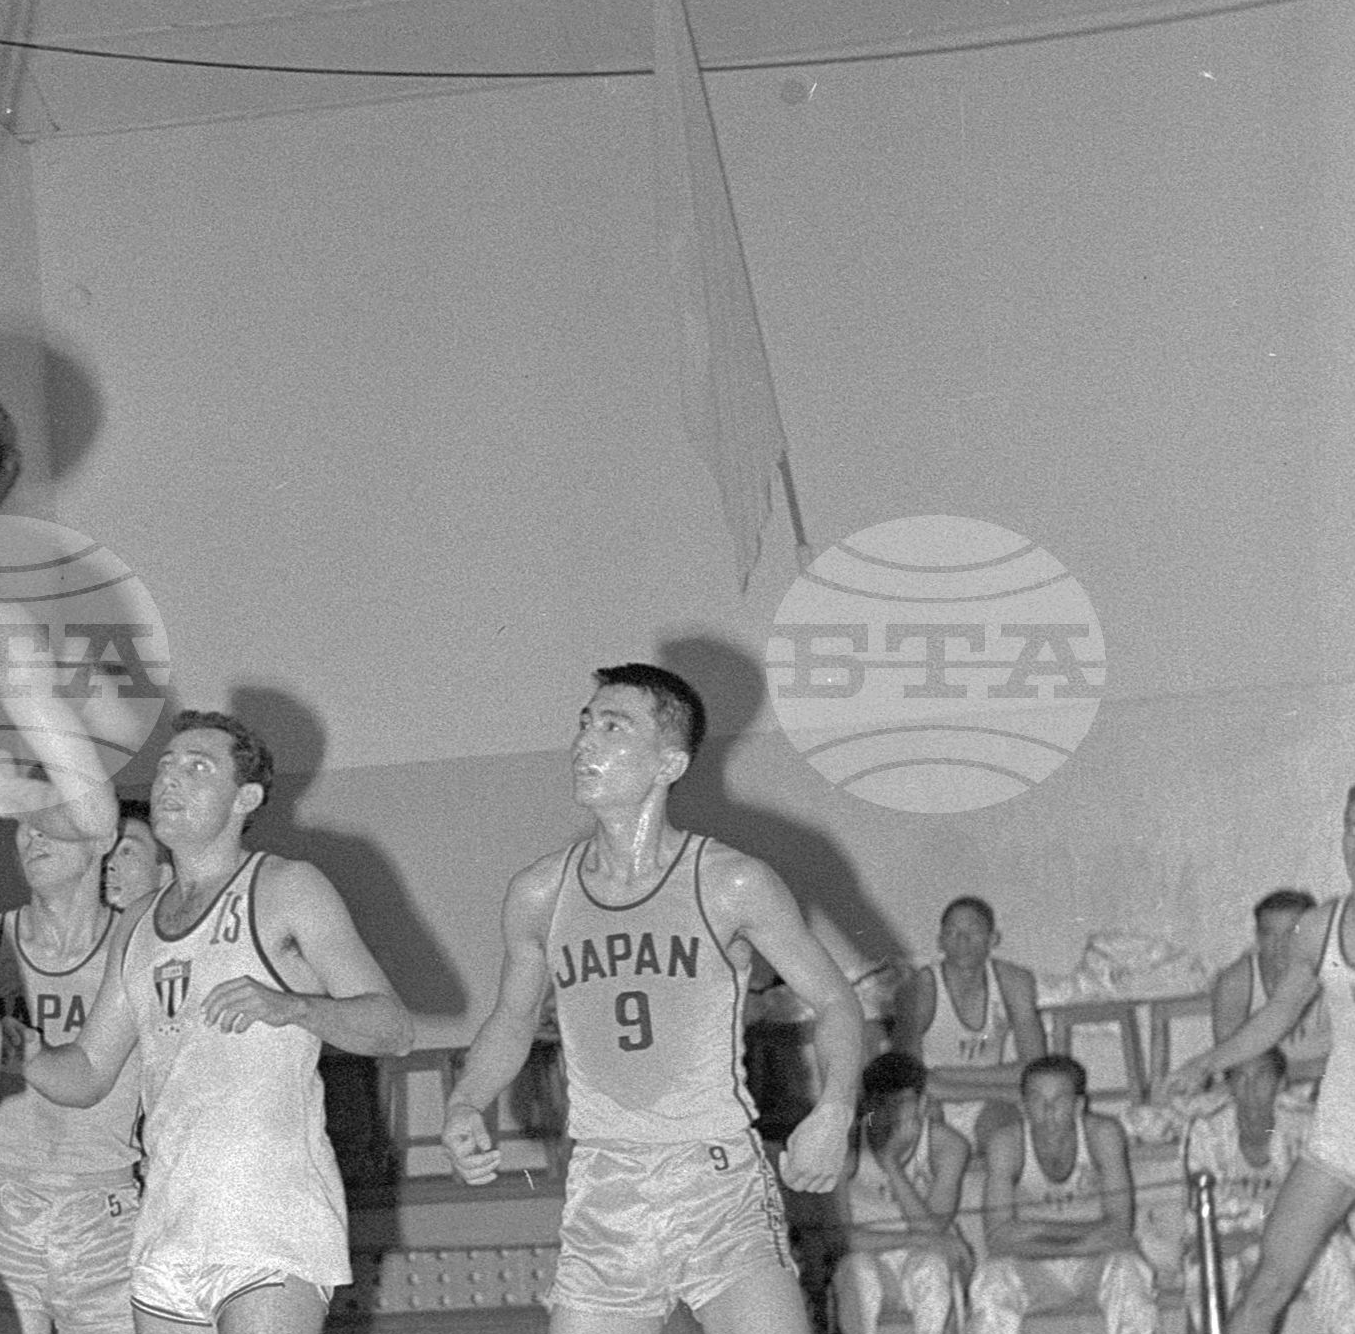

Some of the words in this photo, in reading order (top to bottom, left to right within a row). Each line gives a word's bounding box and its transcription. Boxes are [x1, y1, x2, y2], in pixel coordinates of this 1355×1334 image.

[556, 931, 699, 989] JAPAN
[613, 990, 654, 1053] 9
[708, 1145, 730, 1172] 9
[107, 1192, 123, 1218] 5
